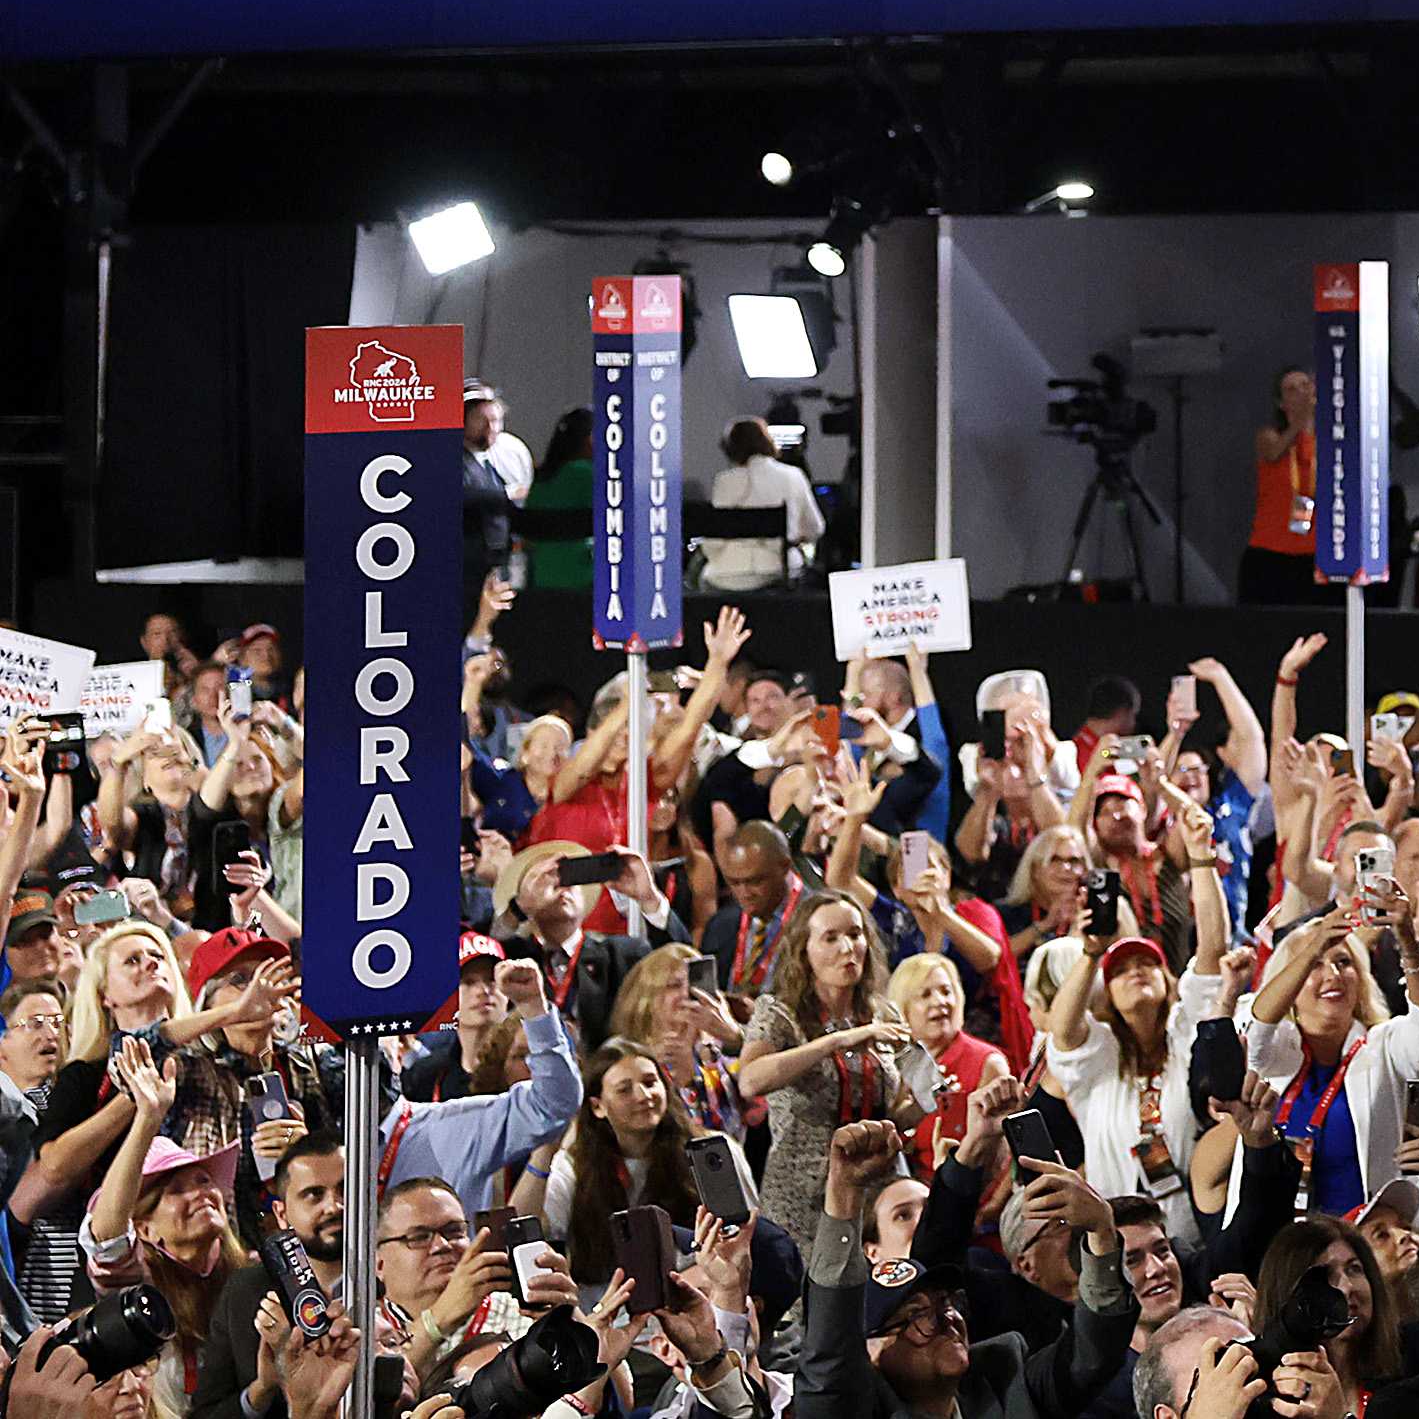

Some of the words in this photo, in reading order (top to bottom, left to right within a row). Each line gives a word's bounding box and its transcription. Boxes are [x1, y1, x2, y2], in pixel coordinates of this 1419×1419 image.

[334, 386, 435, 402] MILWAUKEE
[363, 379, 382, 387] RNC
[383, 379, 406, 387] 2024
[606, 394, 623, 621] COLUMBIA
[650, 393, 667, 619] COLUMBIA
[352, 455, 415, 988] COLORADO
